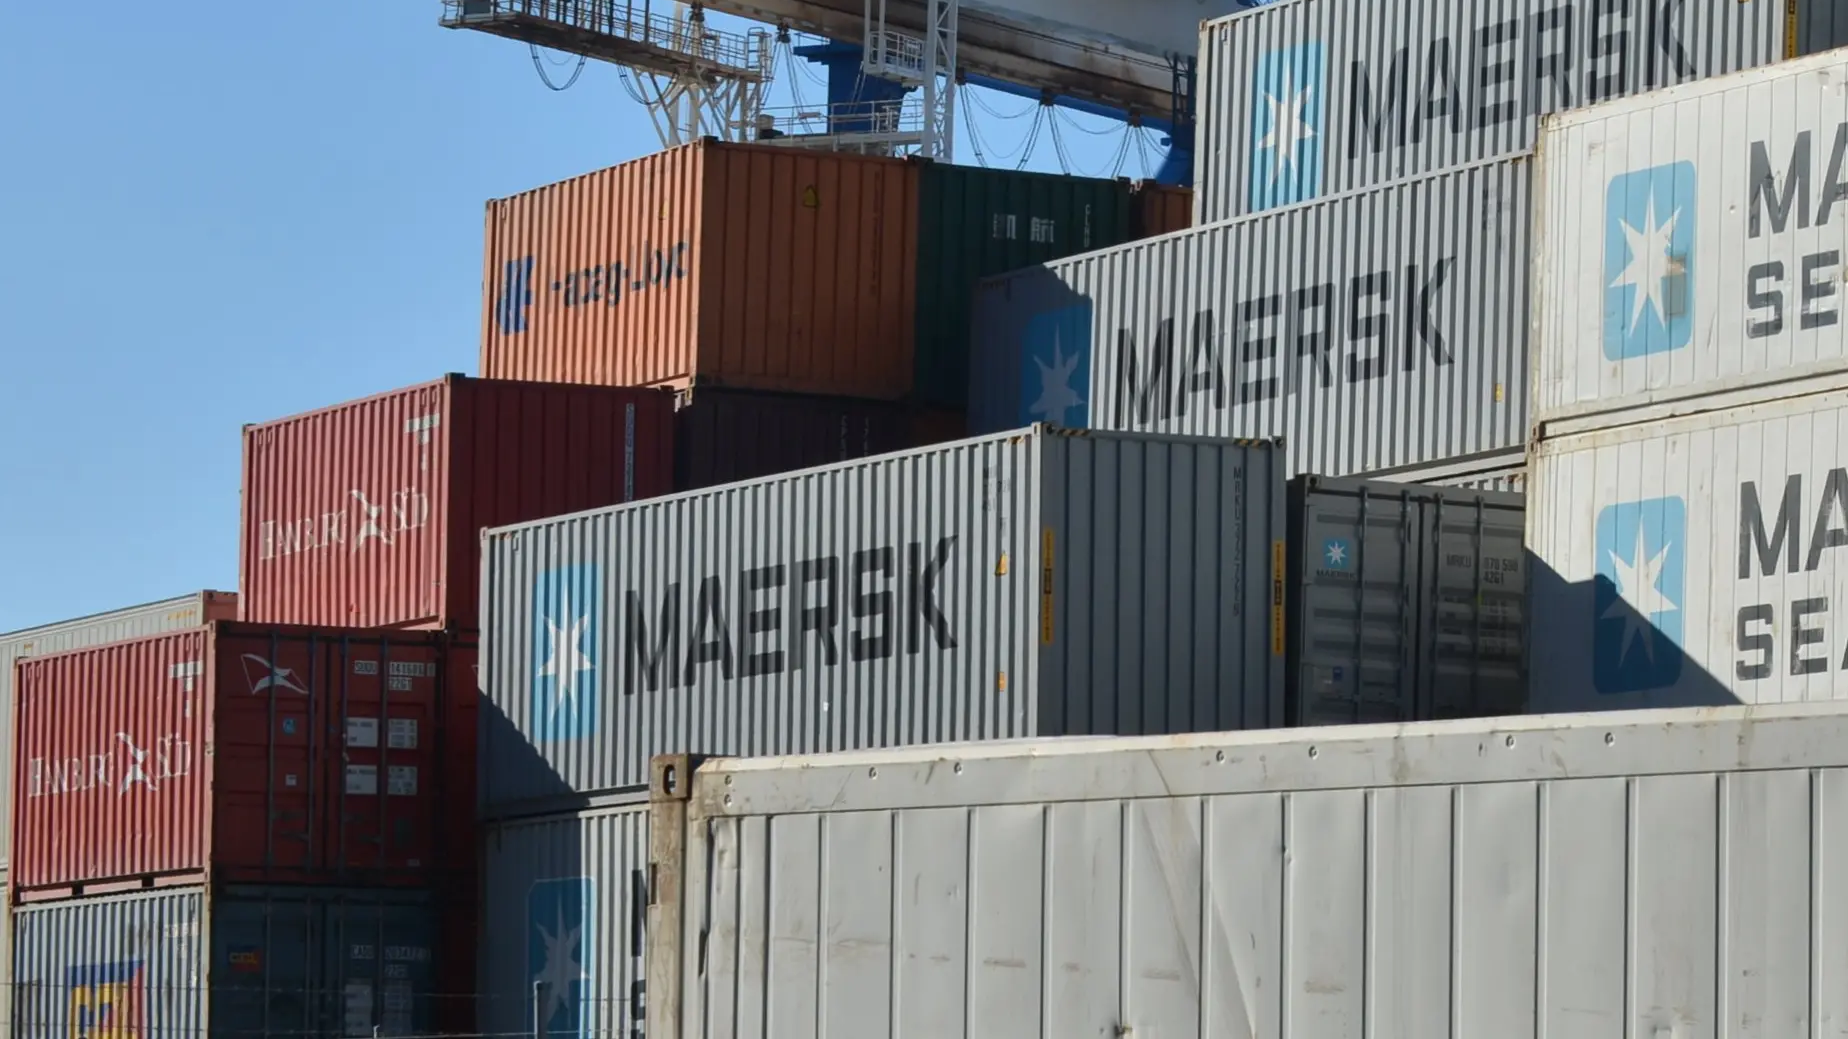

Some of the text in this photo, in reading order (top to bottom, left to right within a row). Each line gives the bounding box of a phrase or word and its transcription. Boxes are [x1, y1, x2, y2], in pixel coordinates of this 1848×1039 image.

[550, 232, 690, 308] apag-Lloyd
[1116, 255, 1455, 428] MAERSK
[624, 535, 960, 696] MAERSK
